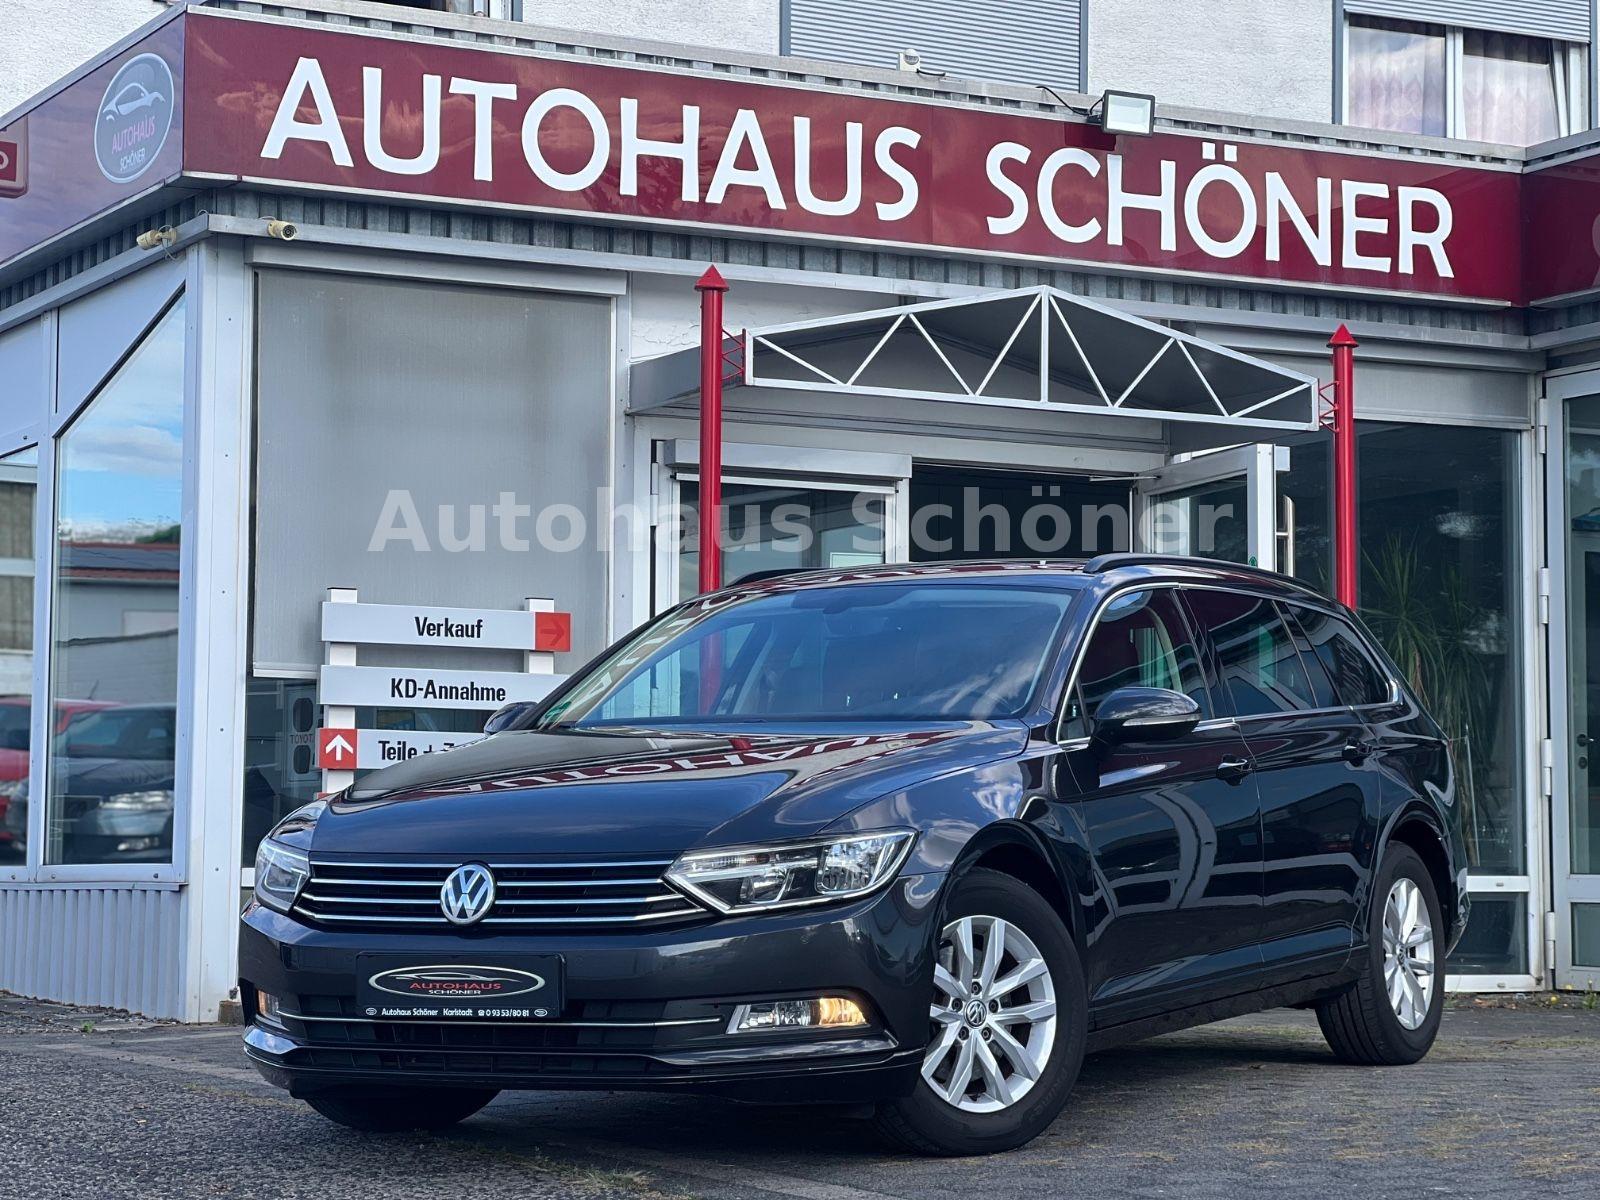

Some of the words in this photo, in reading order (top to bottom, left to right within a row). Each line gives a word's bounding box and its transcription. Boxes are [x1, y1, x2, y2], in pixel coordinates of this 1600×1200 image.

[112, 114, 156, 154] AUTOHAUS
[120, 147, 146, 171] SCHÖNER
[260, 56, 922, 221] AUTOHAUS
[985, 141, 1454, 279] SCHÖNER
[415, 616, 484, 638] Verkauf
[391, 678, 507, 701] KD-Annahme
[378, 740, 418, 760] Teile
[409, 982, 502, 990] AUTOHAUS
[381, 1008, 412, 1016] Autohaus
[412, 1008, 439, 1017] Schöner
[443, 1008, 473, 1017] Karlstadt
